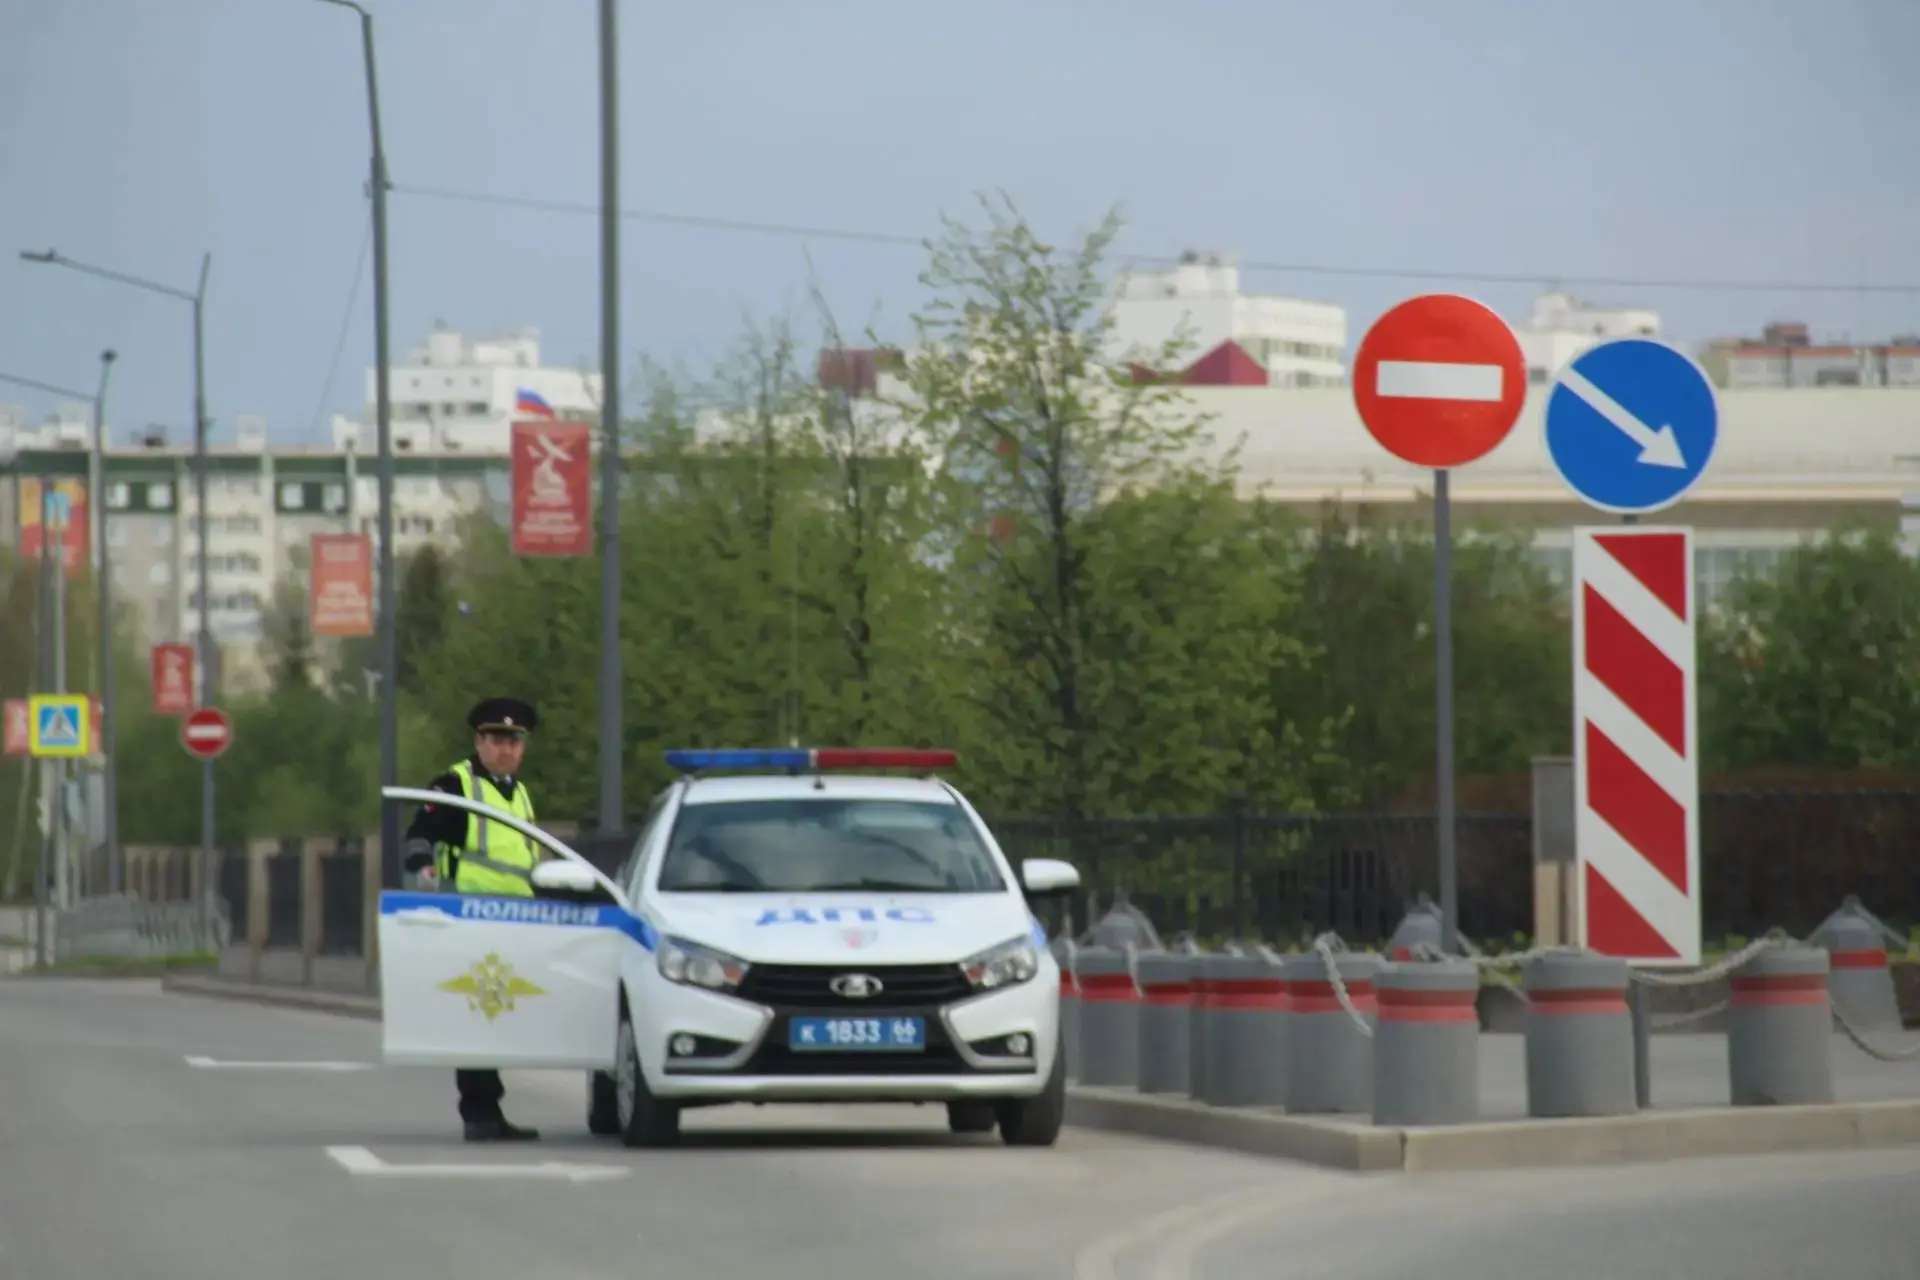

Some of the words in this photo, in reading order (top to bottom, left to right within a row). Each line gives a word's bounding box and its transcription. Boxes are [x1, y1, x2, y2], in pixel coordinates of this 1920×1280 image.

[460, 899, 600, 926] ПОЛИЦИЯ
[756, 906, 936, 926] ДПС
[825, 1019, 882, 1044] 1833
[893, 1017, 917, 1037] 66
